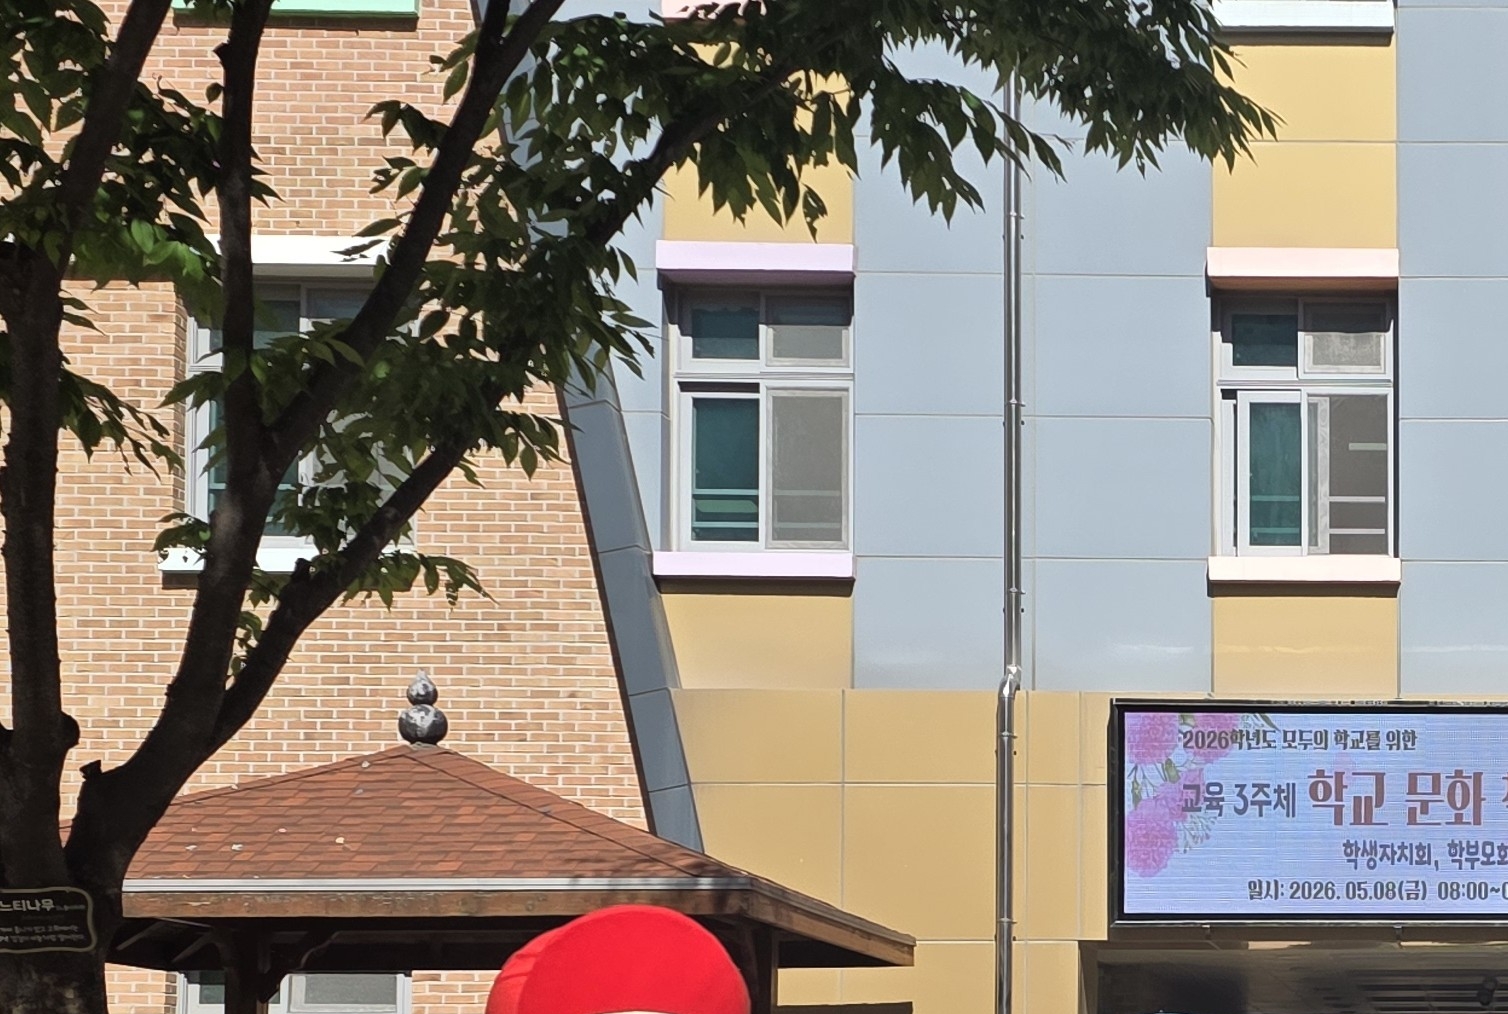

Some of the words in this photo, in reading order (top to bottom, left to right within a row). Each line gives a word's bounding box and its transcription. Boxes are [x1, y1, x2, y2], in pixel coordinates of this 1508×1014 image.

[1183, 729, 1277, 750] 2026학년도
[1282, 729, 1328, 750] 모두의
[1334, 729, 1381, 750] 학교를
[1386, 729, 1418, 750] 위한
[1182, 782, 1225, 817] 교육
[1233, 782, 1296, 818] 3주체
[1308, 769, 1389, 826] 학교
[1405, 769, 1487, 826] 문화
[1343, 839, 1439, 872] 학생자치회,
[1248, 879, 1284, 900] 일시:
